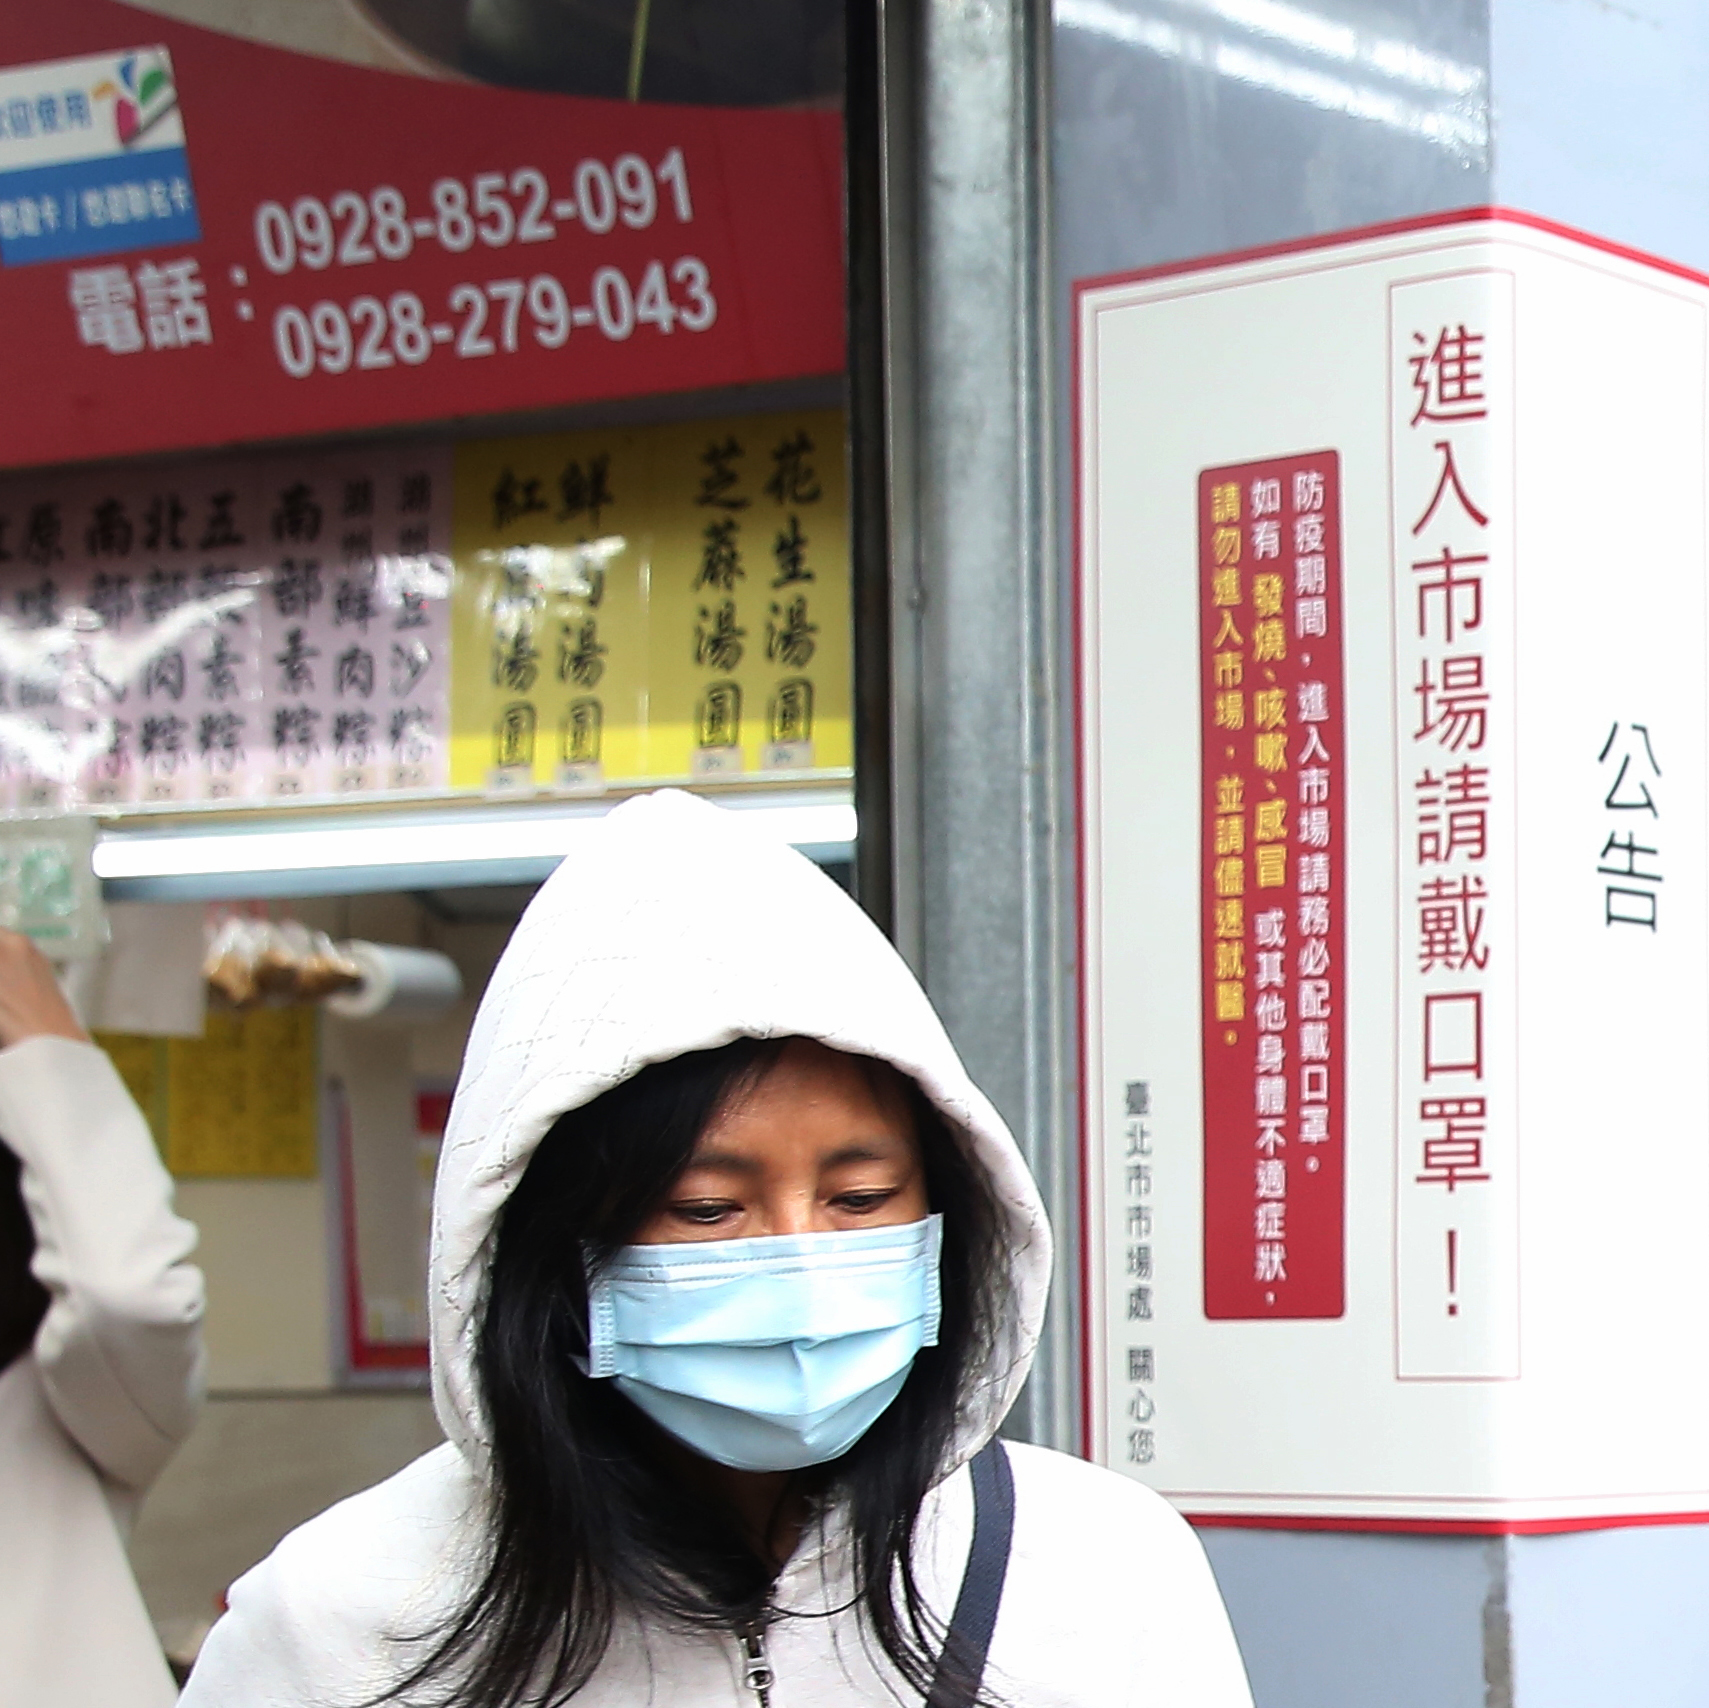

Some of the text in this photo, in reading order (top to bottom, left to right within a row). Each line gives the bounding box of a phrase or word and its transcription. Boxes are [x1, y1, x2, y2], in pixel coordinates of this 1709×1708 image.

[255, 147, 694, 275] 0928-852-091
[273, 256, 718, 377] 0928-279-043
[1408, 323, 1490, 1316] 進入市場請戴口罩！
[1598, 722, 1664, 932] 公告
